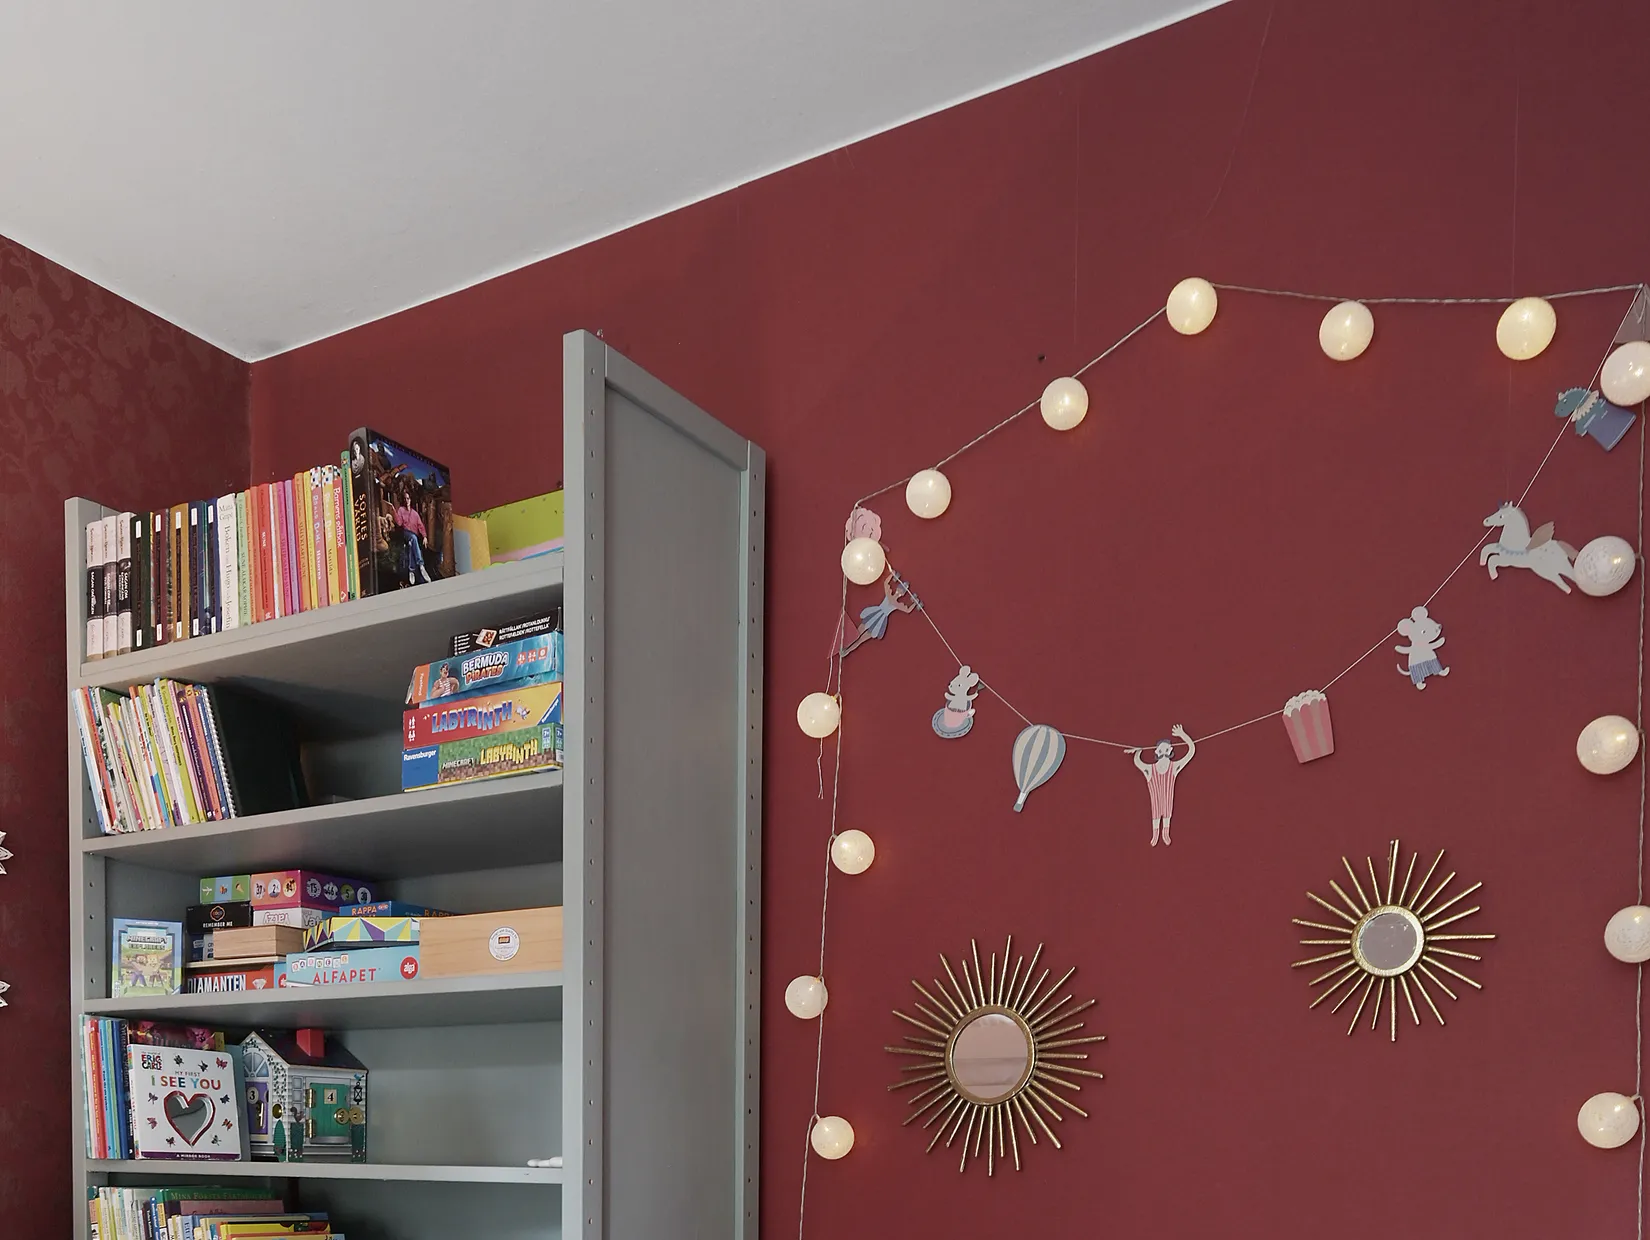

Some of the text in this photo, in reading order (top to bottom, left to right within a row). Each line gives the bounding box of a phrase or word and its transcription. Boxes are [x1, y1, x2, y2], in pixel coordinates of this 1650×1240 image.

[359, 493, 368, 541] SOFIES
[223, 526, 231, 553] Boken
[224, 600, 232, 628] Josefin
[463, 653, 508, 673] BERMUDA
[431, 700, 513, 733] LABYRINTH
[403, 750, 437, 762] Ravensburger
[442, 738, 539, 769] MINECRAFT LABYRINTH
[352, 905, 377, 916] RAPPA
[127, 935, 167, 944] MINECRAFT
[313, 968, 377, 984] ALFAPET
[188, 974, 246, 994] DIAMANTEN
[141, 1054, 162, 1062] ERIC
[141, 1061, 162, 1070] CARLE
[161, 1076, 186, 1088] SEE
[191, 1078, 221, 1090] YOU
[249, 1090, 256, 1099] 3
[328, 1092, 334, 1101] 4
[183, 1222, 191, 1235] Ett
